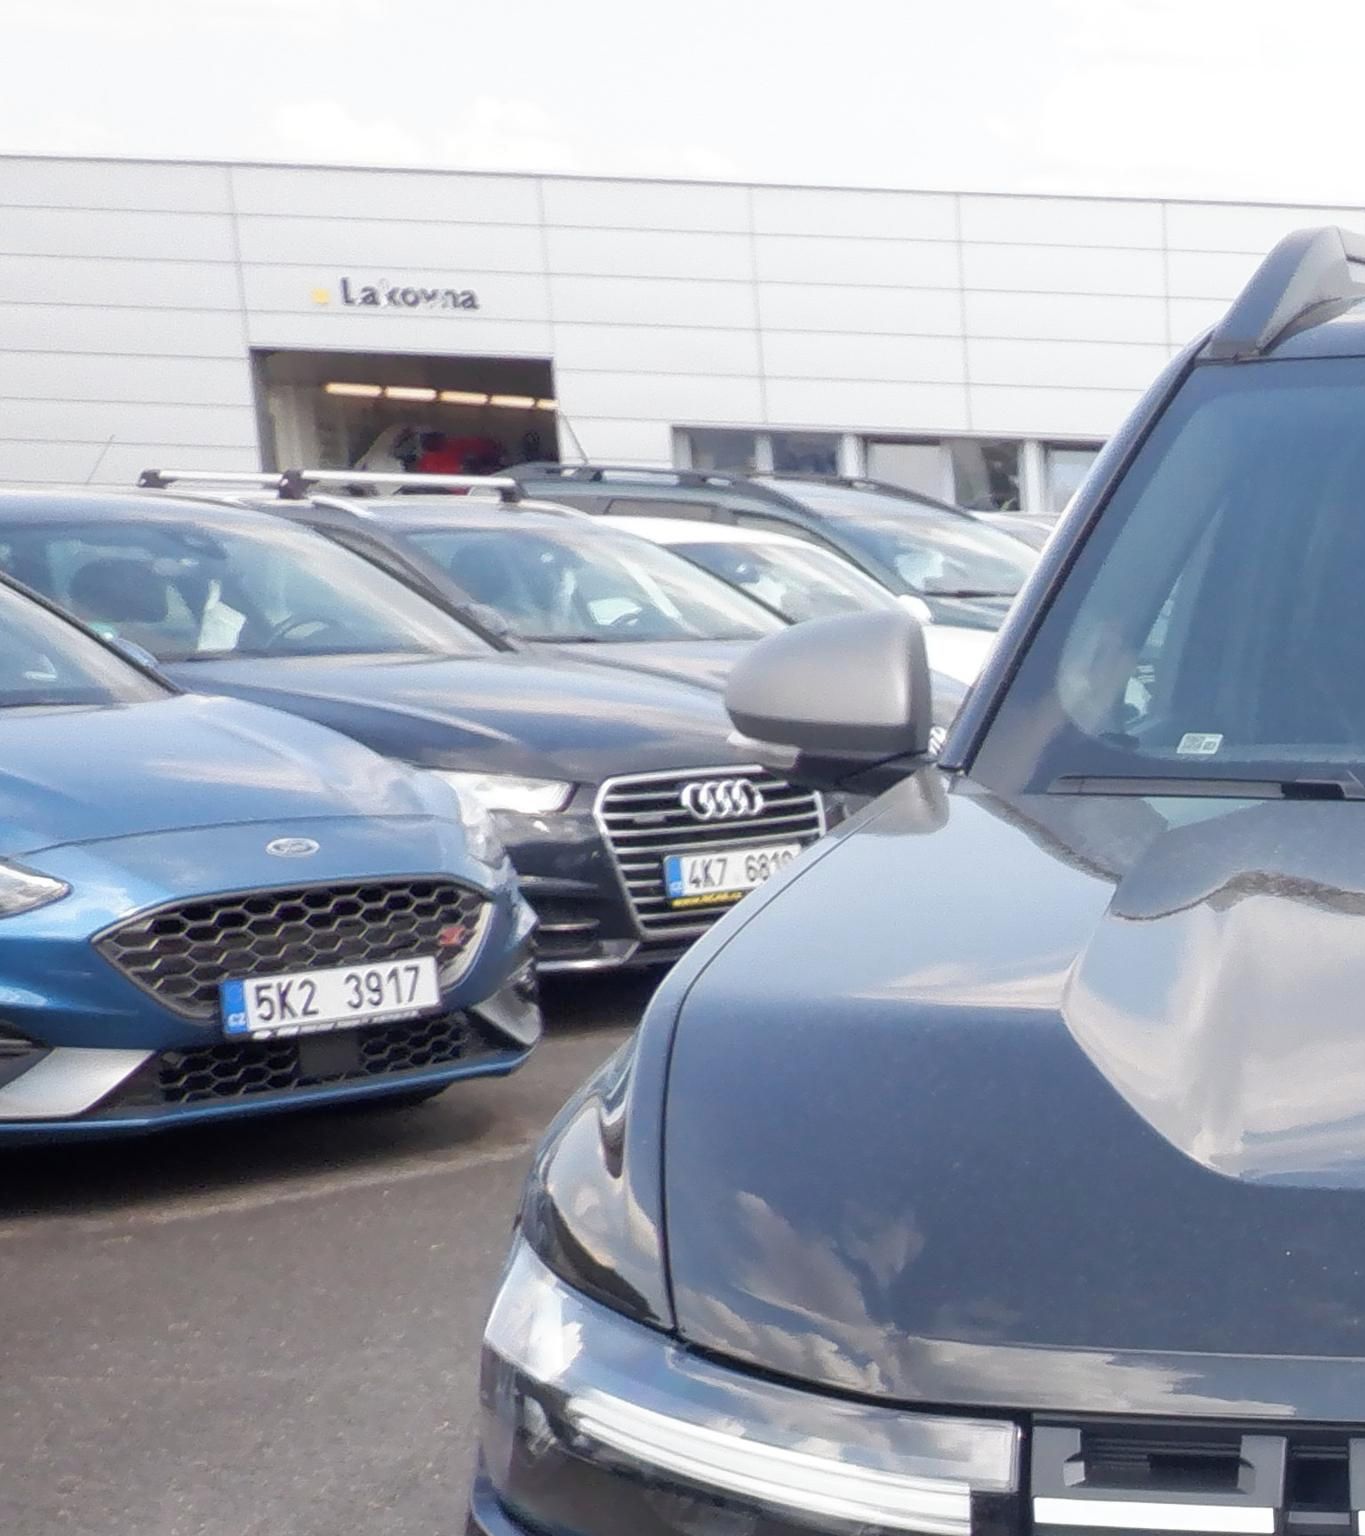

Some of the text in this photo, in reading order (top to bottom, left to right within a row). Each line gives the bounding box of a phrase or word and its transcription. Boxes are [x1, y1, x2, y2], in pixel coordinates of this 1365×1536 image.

[689, 857, 728, 888] 4K7
[255, 964, 420, 1021] 5K2 3917
[227, 1012, 246, 1027] CZ
